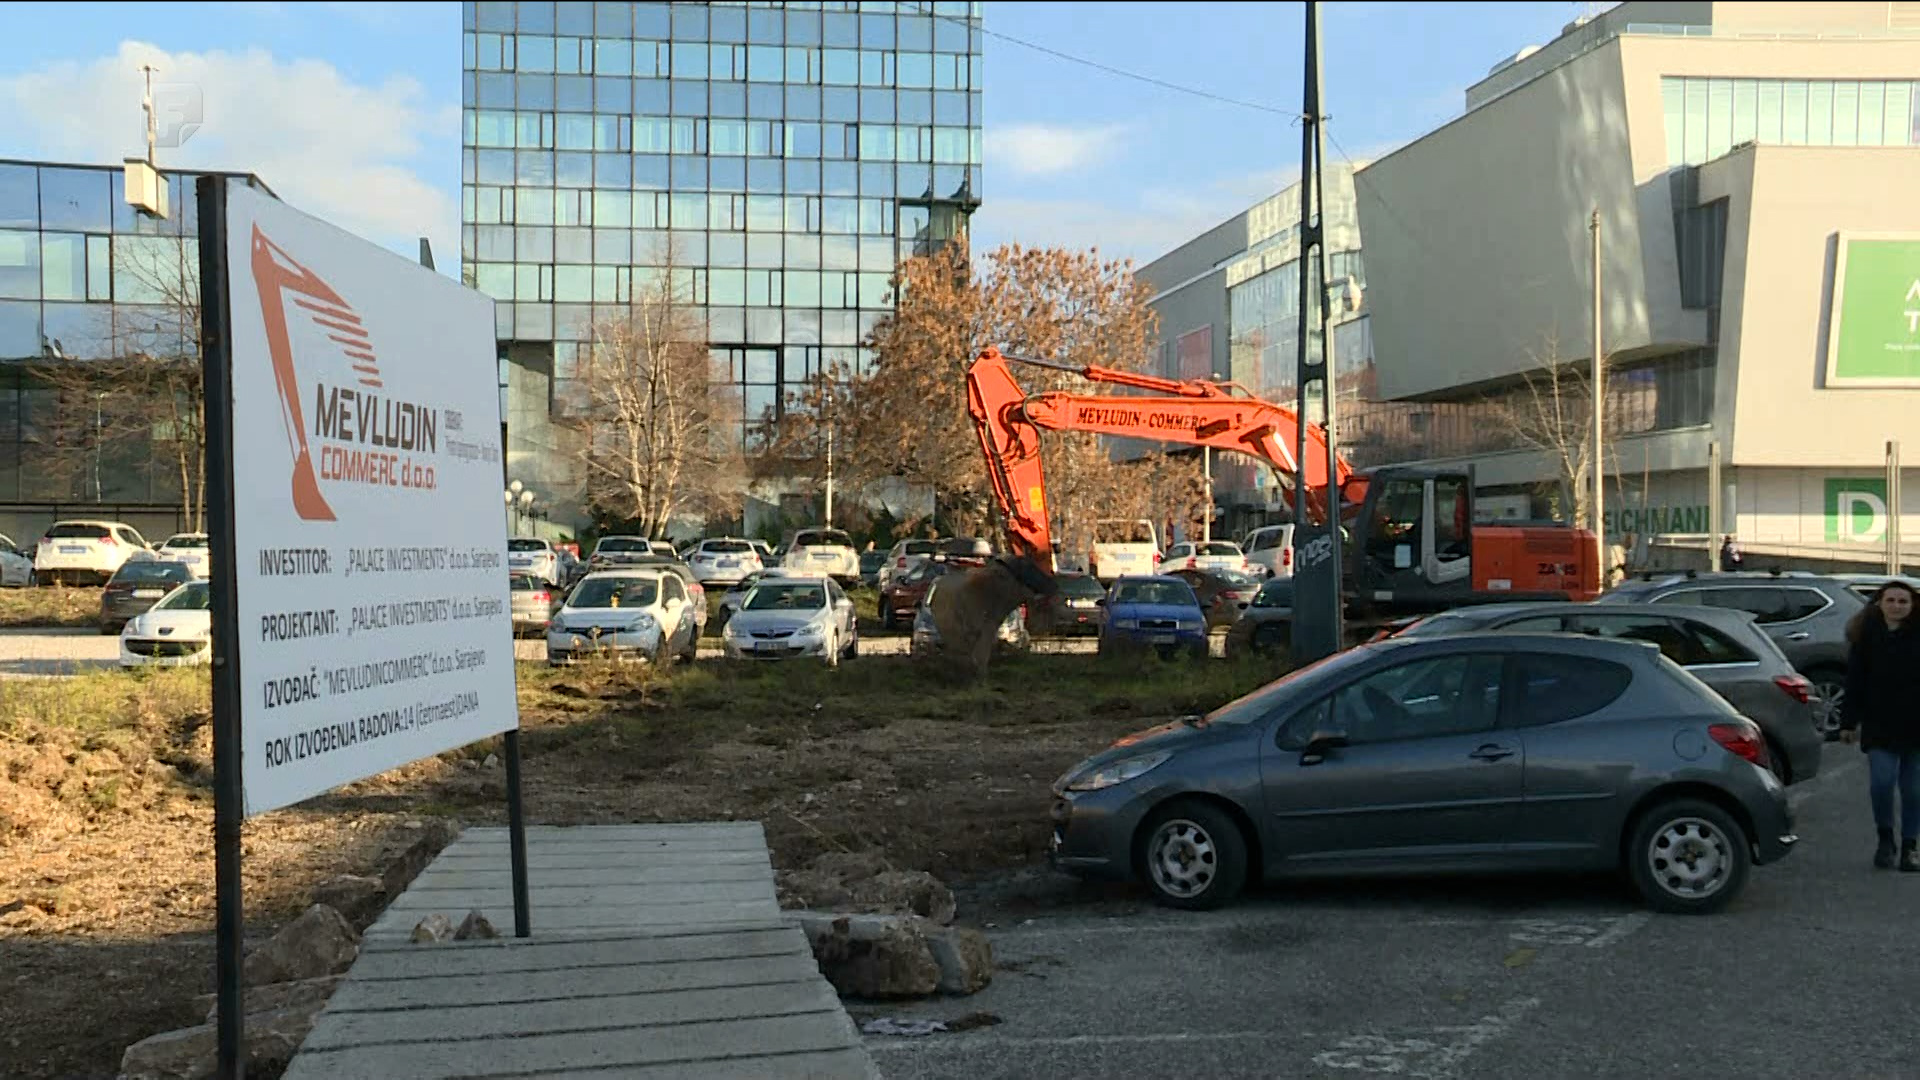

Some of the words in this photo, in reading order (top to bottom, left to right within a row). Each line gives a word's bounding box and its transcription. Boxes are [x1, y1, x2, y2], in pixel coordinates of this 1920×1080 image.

[315, 383, 436, 454] MEVLUDIN
[1077, 407, 1142, 426] MEVLUDIN
[321, 444, 398, 486] COMMERC
[402, 457, 437, 490] d.o.o.
[260, 548, 332, 576] INVESTITOR:
[471, 548, 500, 573] Sarajevo
[262, 609, 340, 642] PROJEKTANT:
[474, 597, 503, 622] Sarajevo
[264, 665, 321, 709] IZVOĐAČ:
[455, 647, 486, 671] Sarajevo
[265, 735, 292, 769] ROK
[295, 719, 357, 759] IZVOĐENJA
